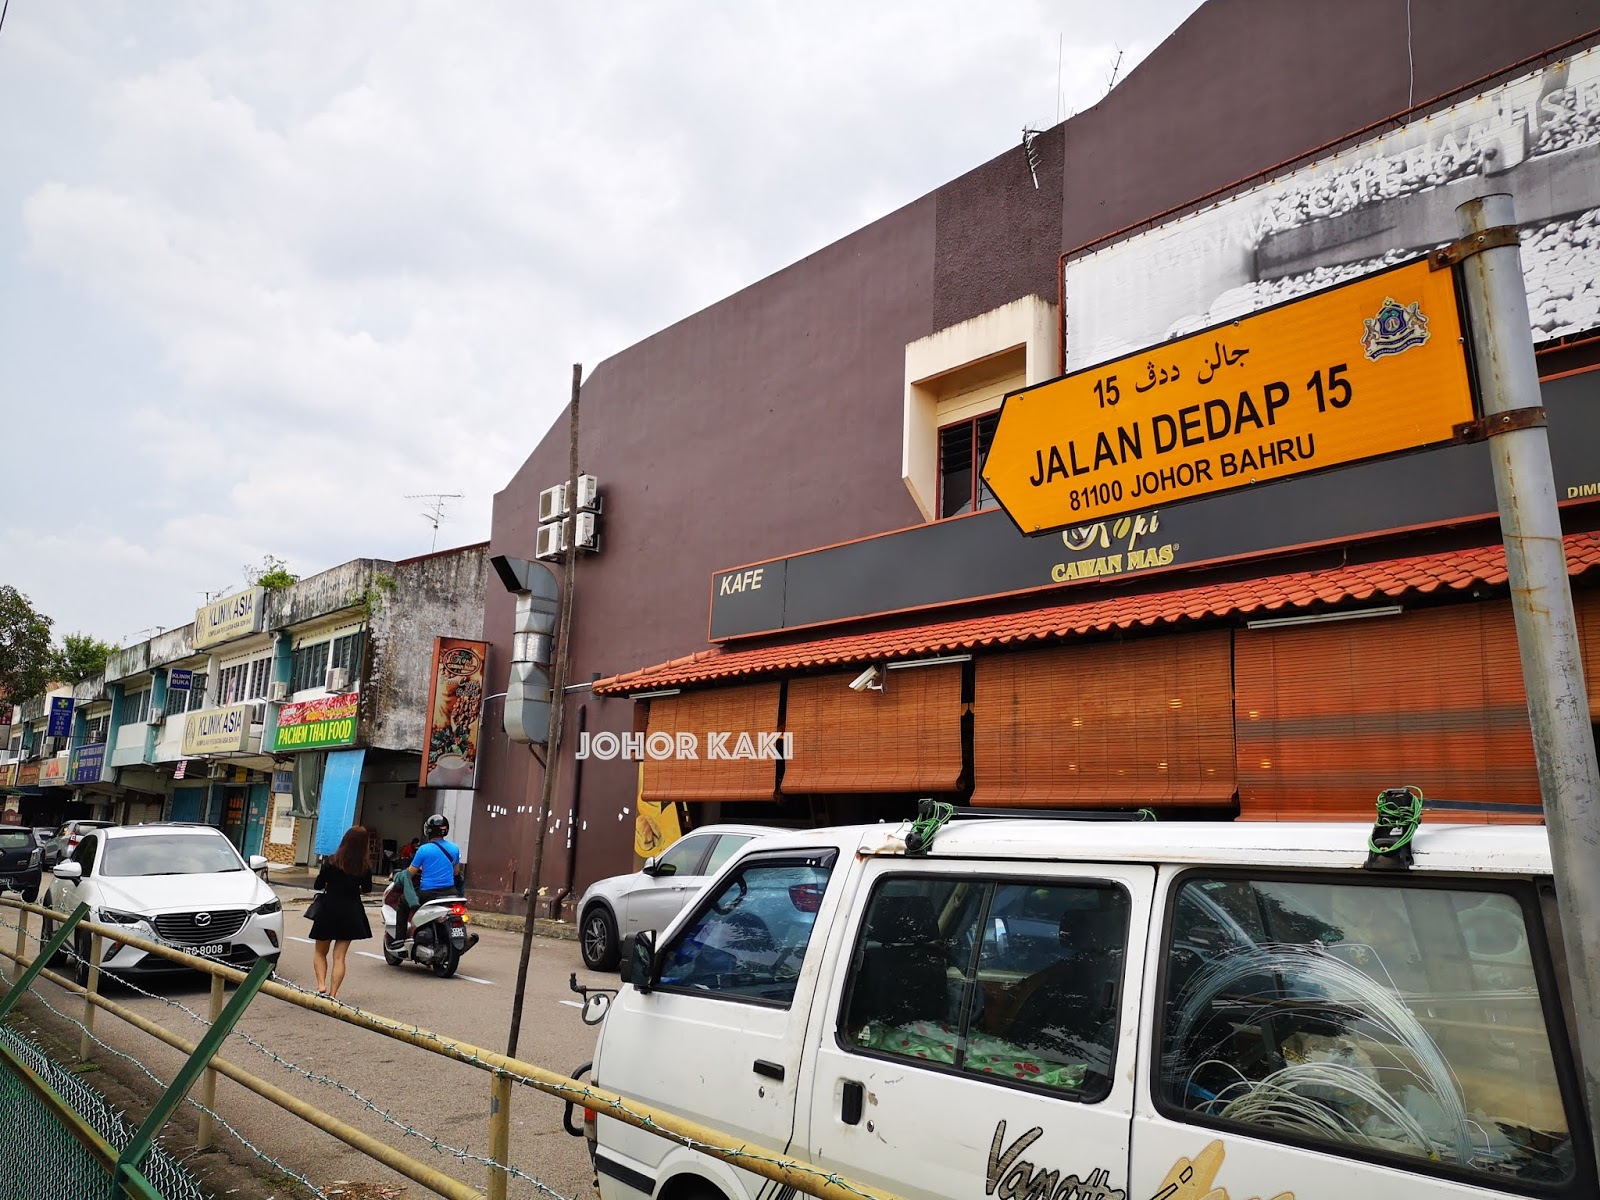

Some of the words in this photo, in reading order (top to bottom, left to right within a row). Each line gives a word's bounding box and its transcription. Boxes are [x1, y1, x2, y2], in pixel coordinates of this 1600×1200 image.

[1197, 342, 1251, 384] جالن
[1093, 375, 1121, 409] 15
[1029, 421, 1142, 487] JALAN
[1152, 381, 1290, 455] DEDAP
[1306, 363, 1353, 413] 15
[1069, 480, 1123, 512] 81100
[1130, 457, 1212, 498] JOHOR
[1220, 433, 1316, 477] BAHRU
[1051, 554, 1123, 583] CAWAN
[1127, 543, 1175, 571] MAS
[719, 568, 764, 597] KAFE
[208, 600, 234, 628] KLINIK
[232, 593, 253, 619] ASIA
[197, 713, 223, 737] KLINIK
[222, 710, 242, 734] ASIA
[277, 724, 308, 746] PACHEM
[308, 722, 327, 743] THAI
[327, 719, 352, 741] FOOD
[199, 944, 223, 955] 8008
